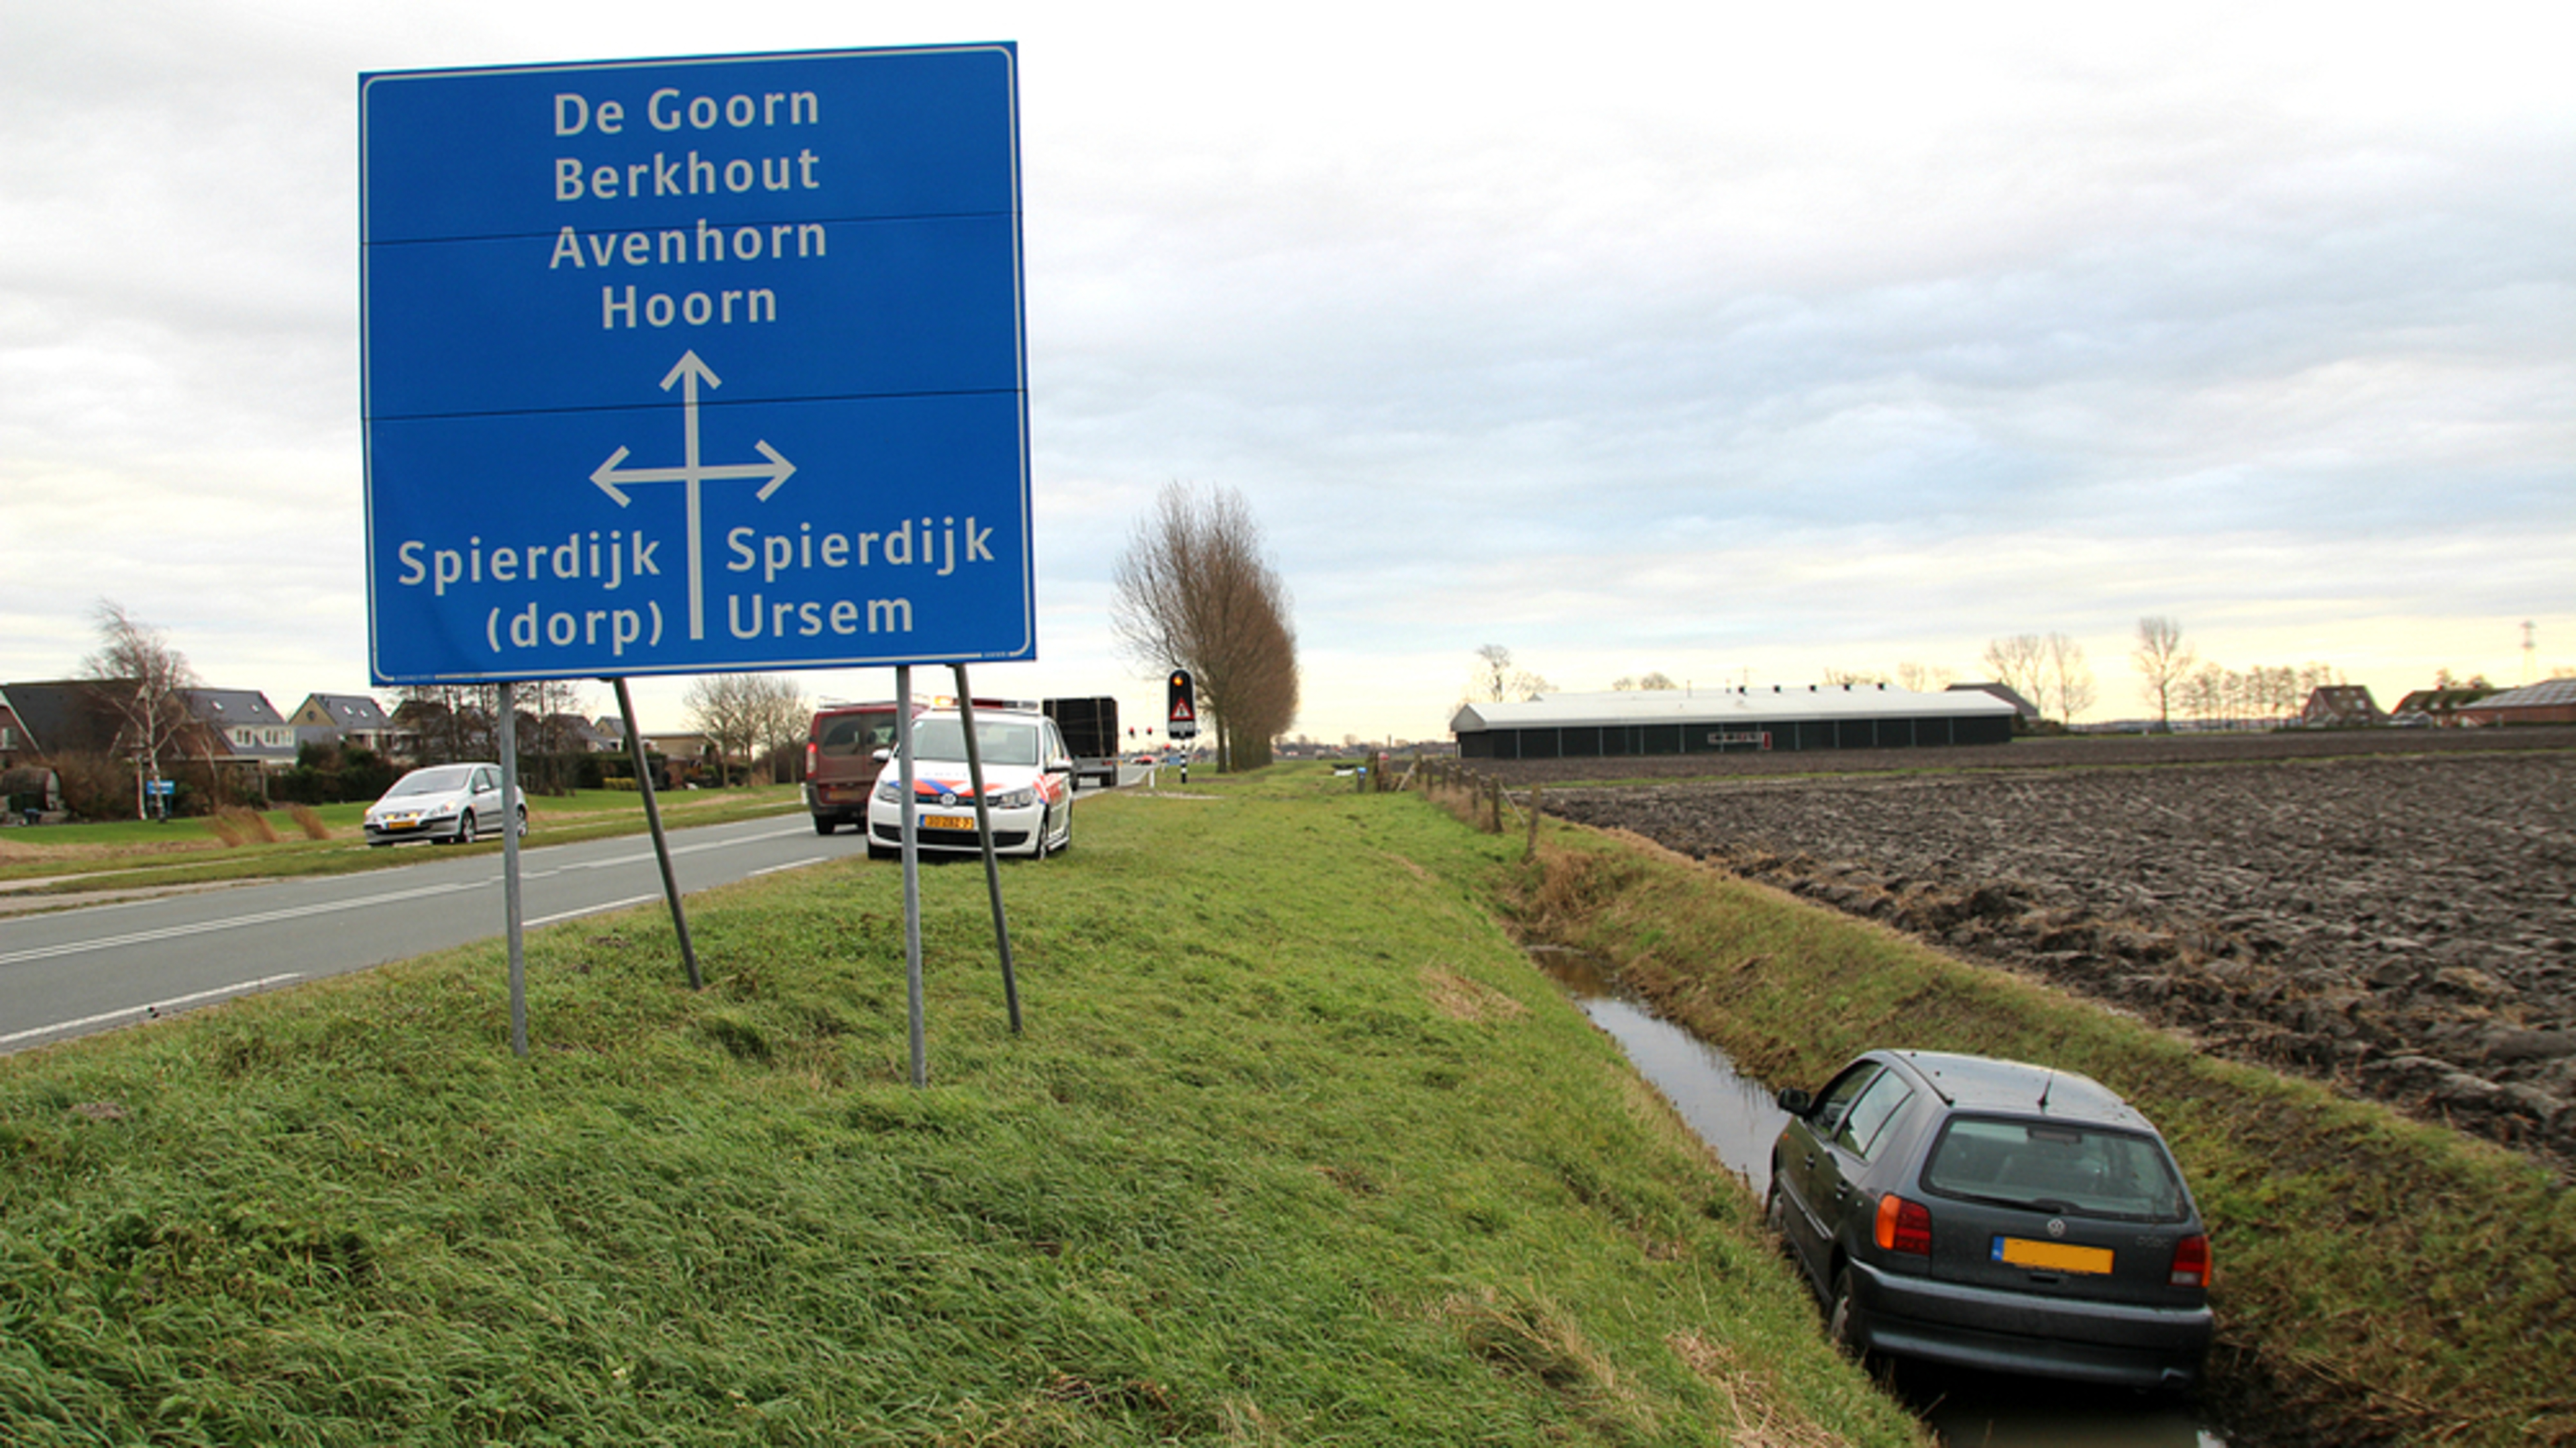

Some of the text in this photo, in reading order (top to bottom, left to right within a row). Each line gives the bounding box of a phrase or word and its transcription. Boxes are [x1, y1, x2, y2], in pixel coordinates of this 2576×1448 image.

[556, 88, 816, 134] De Goorn
[556, 149, 818, 200] Berkhout
[550, 219, 825, 268] Avenhorn
[603, 286, 775, 328] Hoorn
[399, 531, 659, 596] Spierdijk
[727, 517, 994, 582] Spierdijk
[487, 603, 662, 656] (dorp)
[729, 594, 912, 638] Ursem
